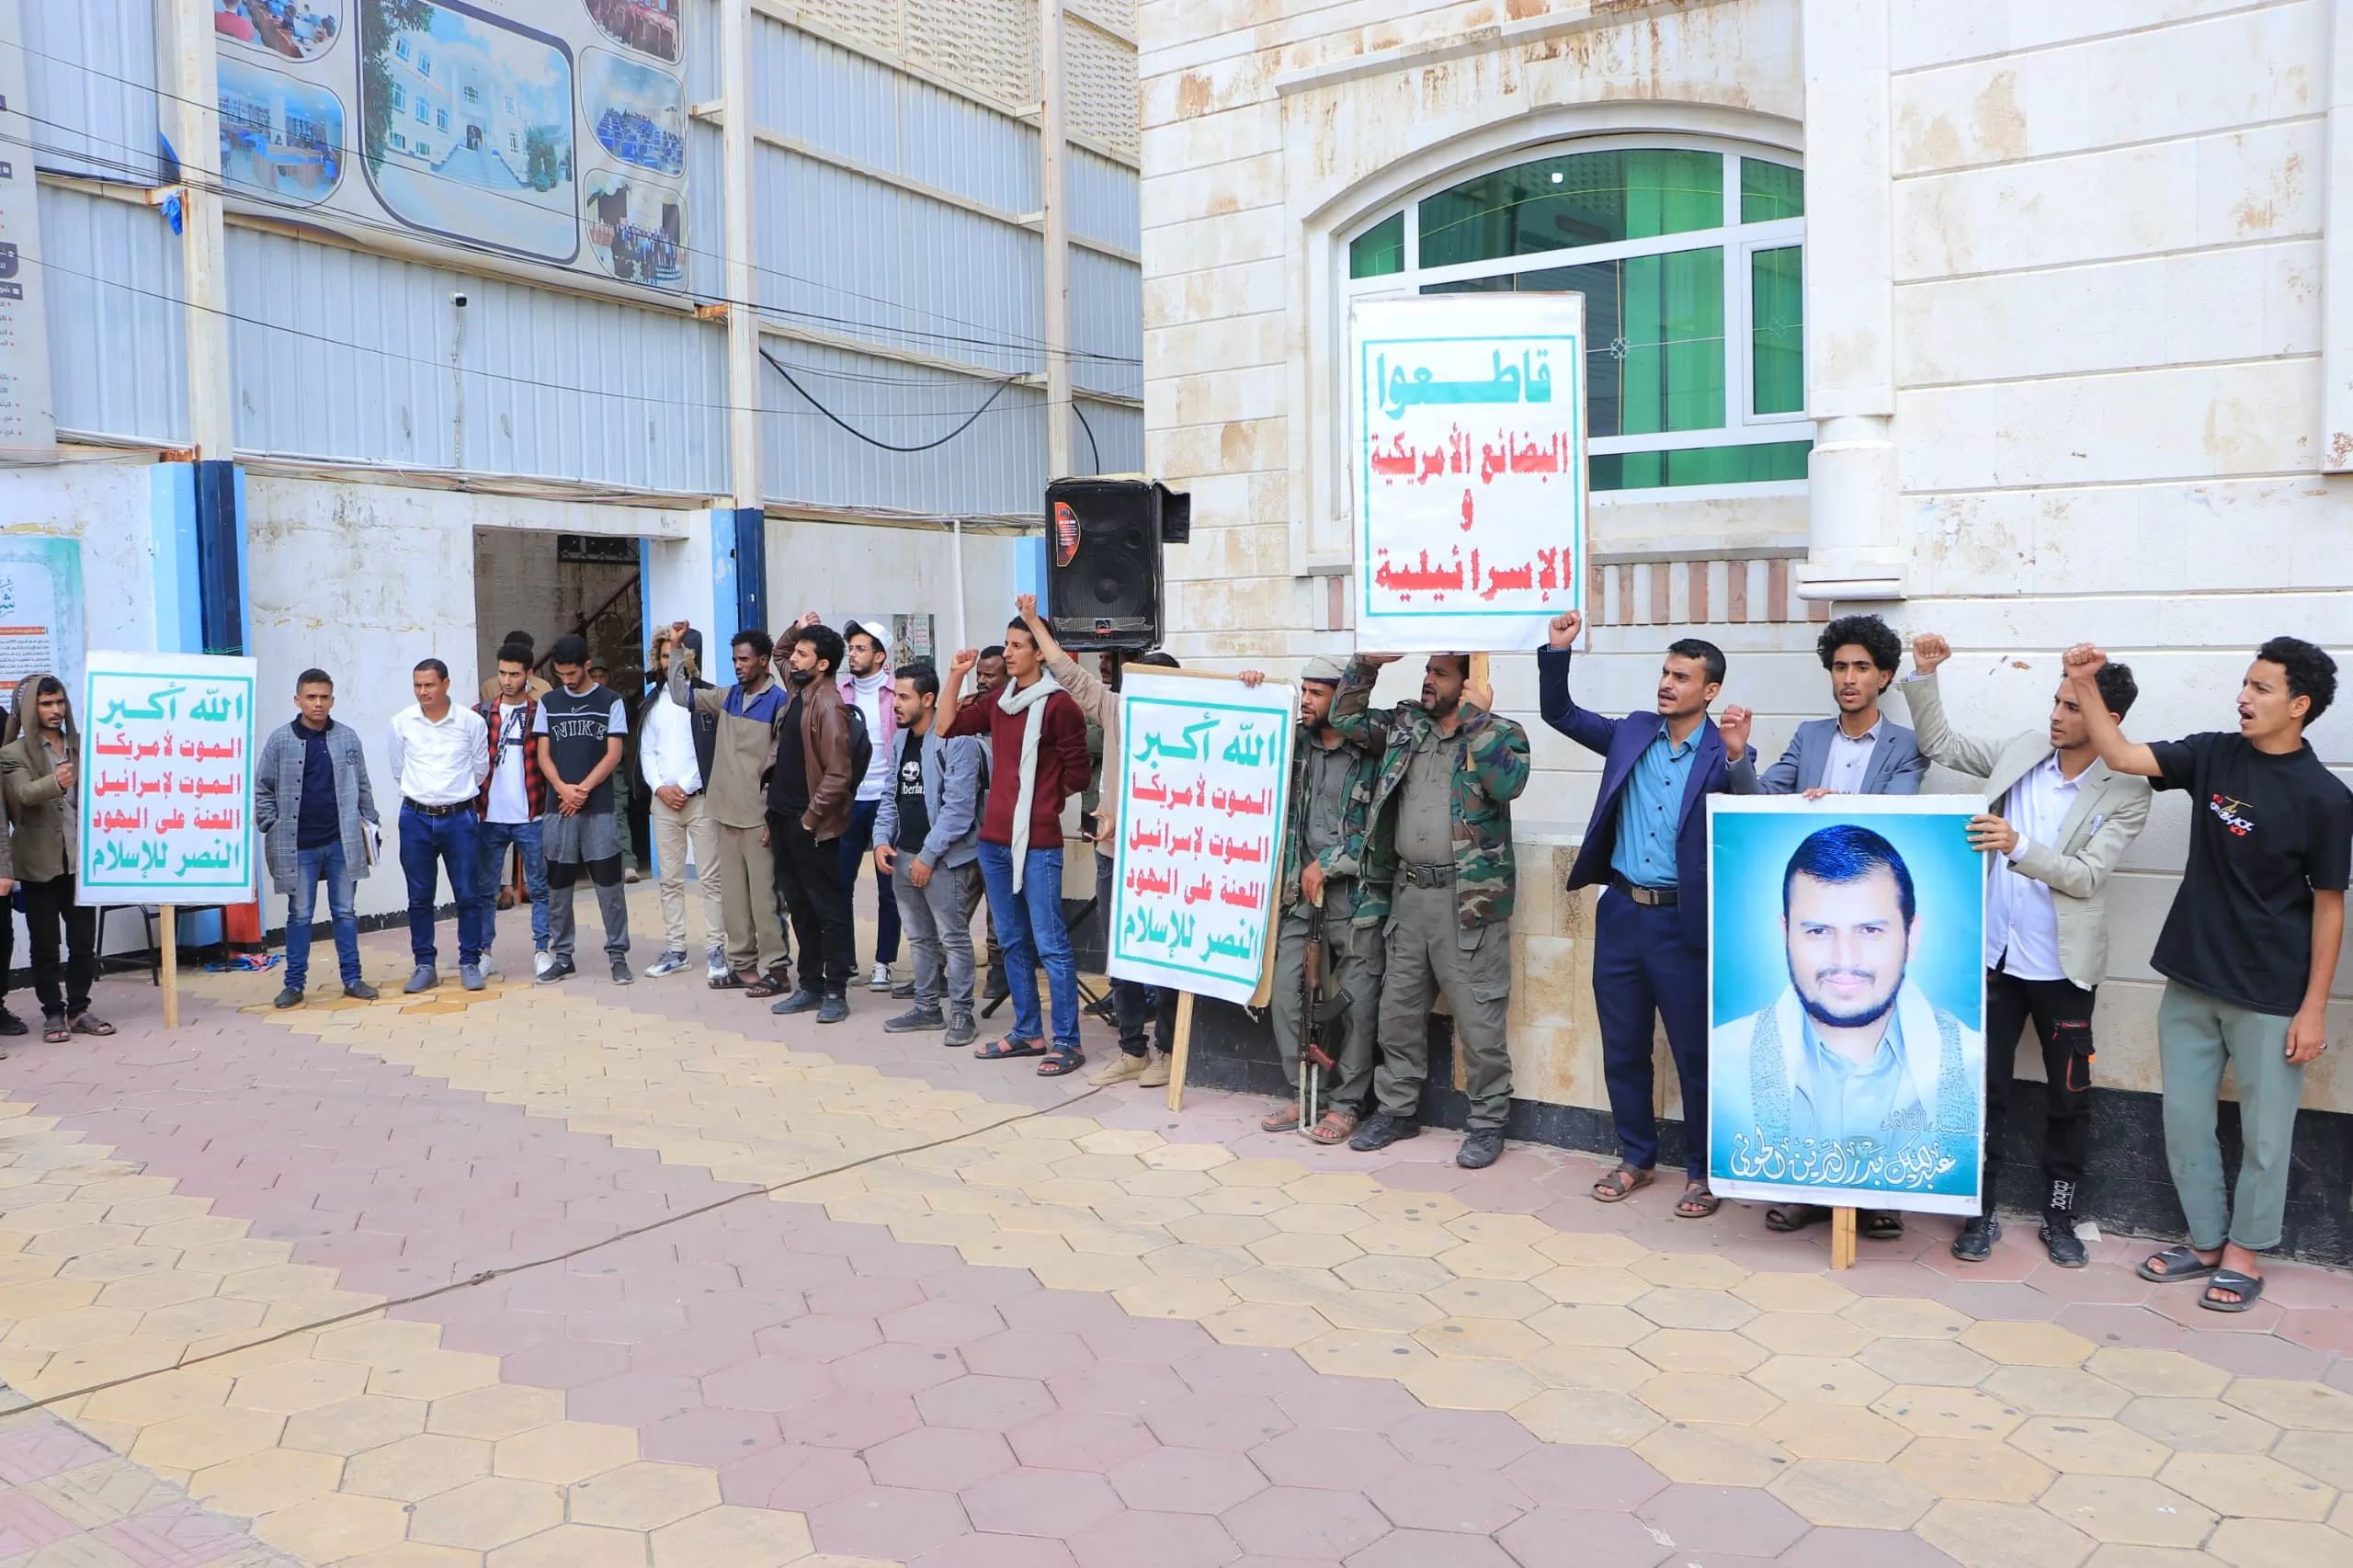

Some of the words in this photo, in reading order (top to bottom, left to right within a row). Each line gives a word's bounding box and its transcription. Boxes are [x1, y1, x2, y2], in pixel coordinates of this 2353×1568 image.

[1377, 350, 1552, 420] قاطعوا
[1371, 423, 1471, 484] الأمريكية
[1482, 428, 1567, 483] البضائع
[1461, 489, 1473, 530] و
[1375, 545, 1571, 601] الإسرائيلية
[97, 684, 185, 729] أكبر
[189, 690, 244, 722] الله
[97, 732, 172, 760] لأمريكا
[551, 720, 608, 741] NIKE
[1133, 714, 1221, 769] أكبر
[1222, 725, 1277, 767] الله
[180, 738, 241, 762] الموت
[95, 771, 172, 797] لإسرائيل
[179, 775, 241, 798] الموت
[1132, 772, 1205, 809] لأمريكا
[194, 808, 240, 829] اللعنة
[1212, 788, 1272, 817] الموت
[94, 808, 147, 833] اليهود
[155, 808, 184, 834] على
[1130, 821, 1202, 859] لإسرائيل
[1210, 834, 1268, 864] الموت
[92, 841, 168, 878] للإسلام
[176, 838, 240, 877] النصر
[1127, 869, 1177, 898] اليهود
[1185, 874, 1211, 904] على
[1221, 877, 1264, 909] اللعنة
[1124, 906, 1195, 958] للإسلام
[1199, 920, 1257, 962] النصر
[1881, 1108, 1927, 1131] القائد
[1927, 1113, 1974, 1137] السيد
